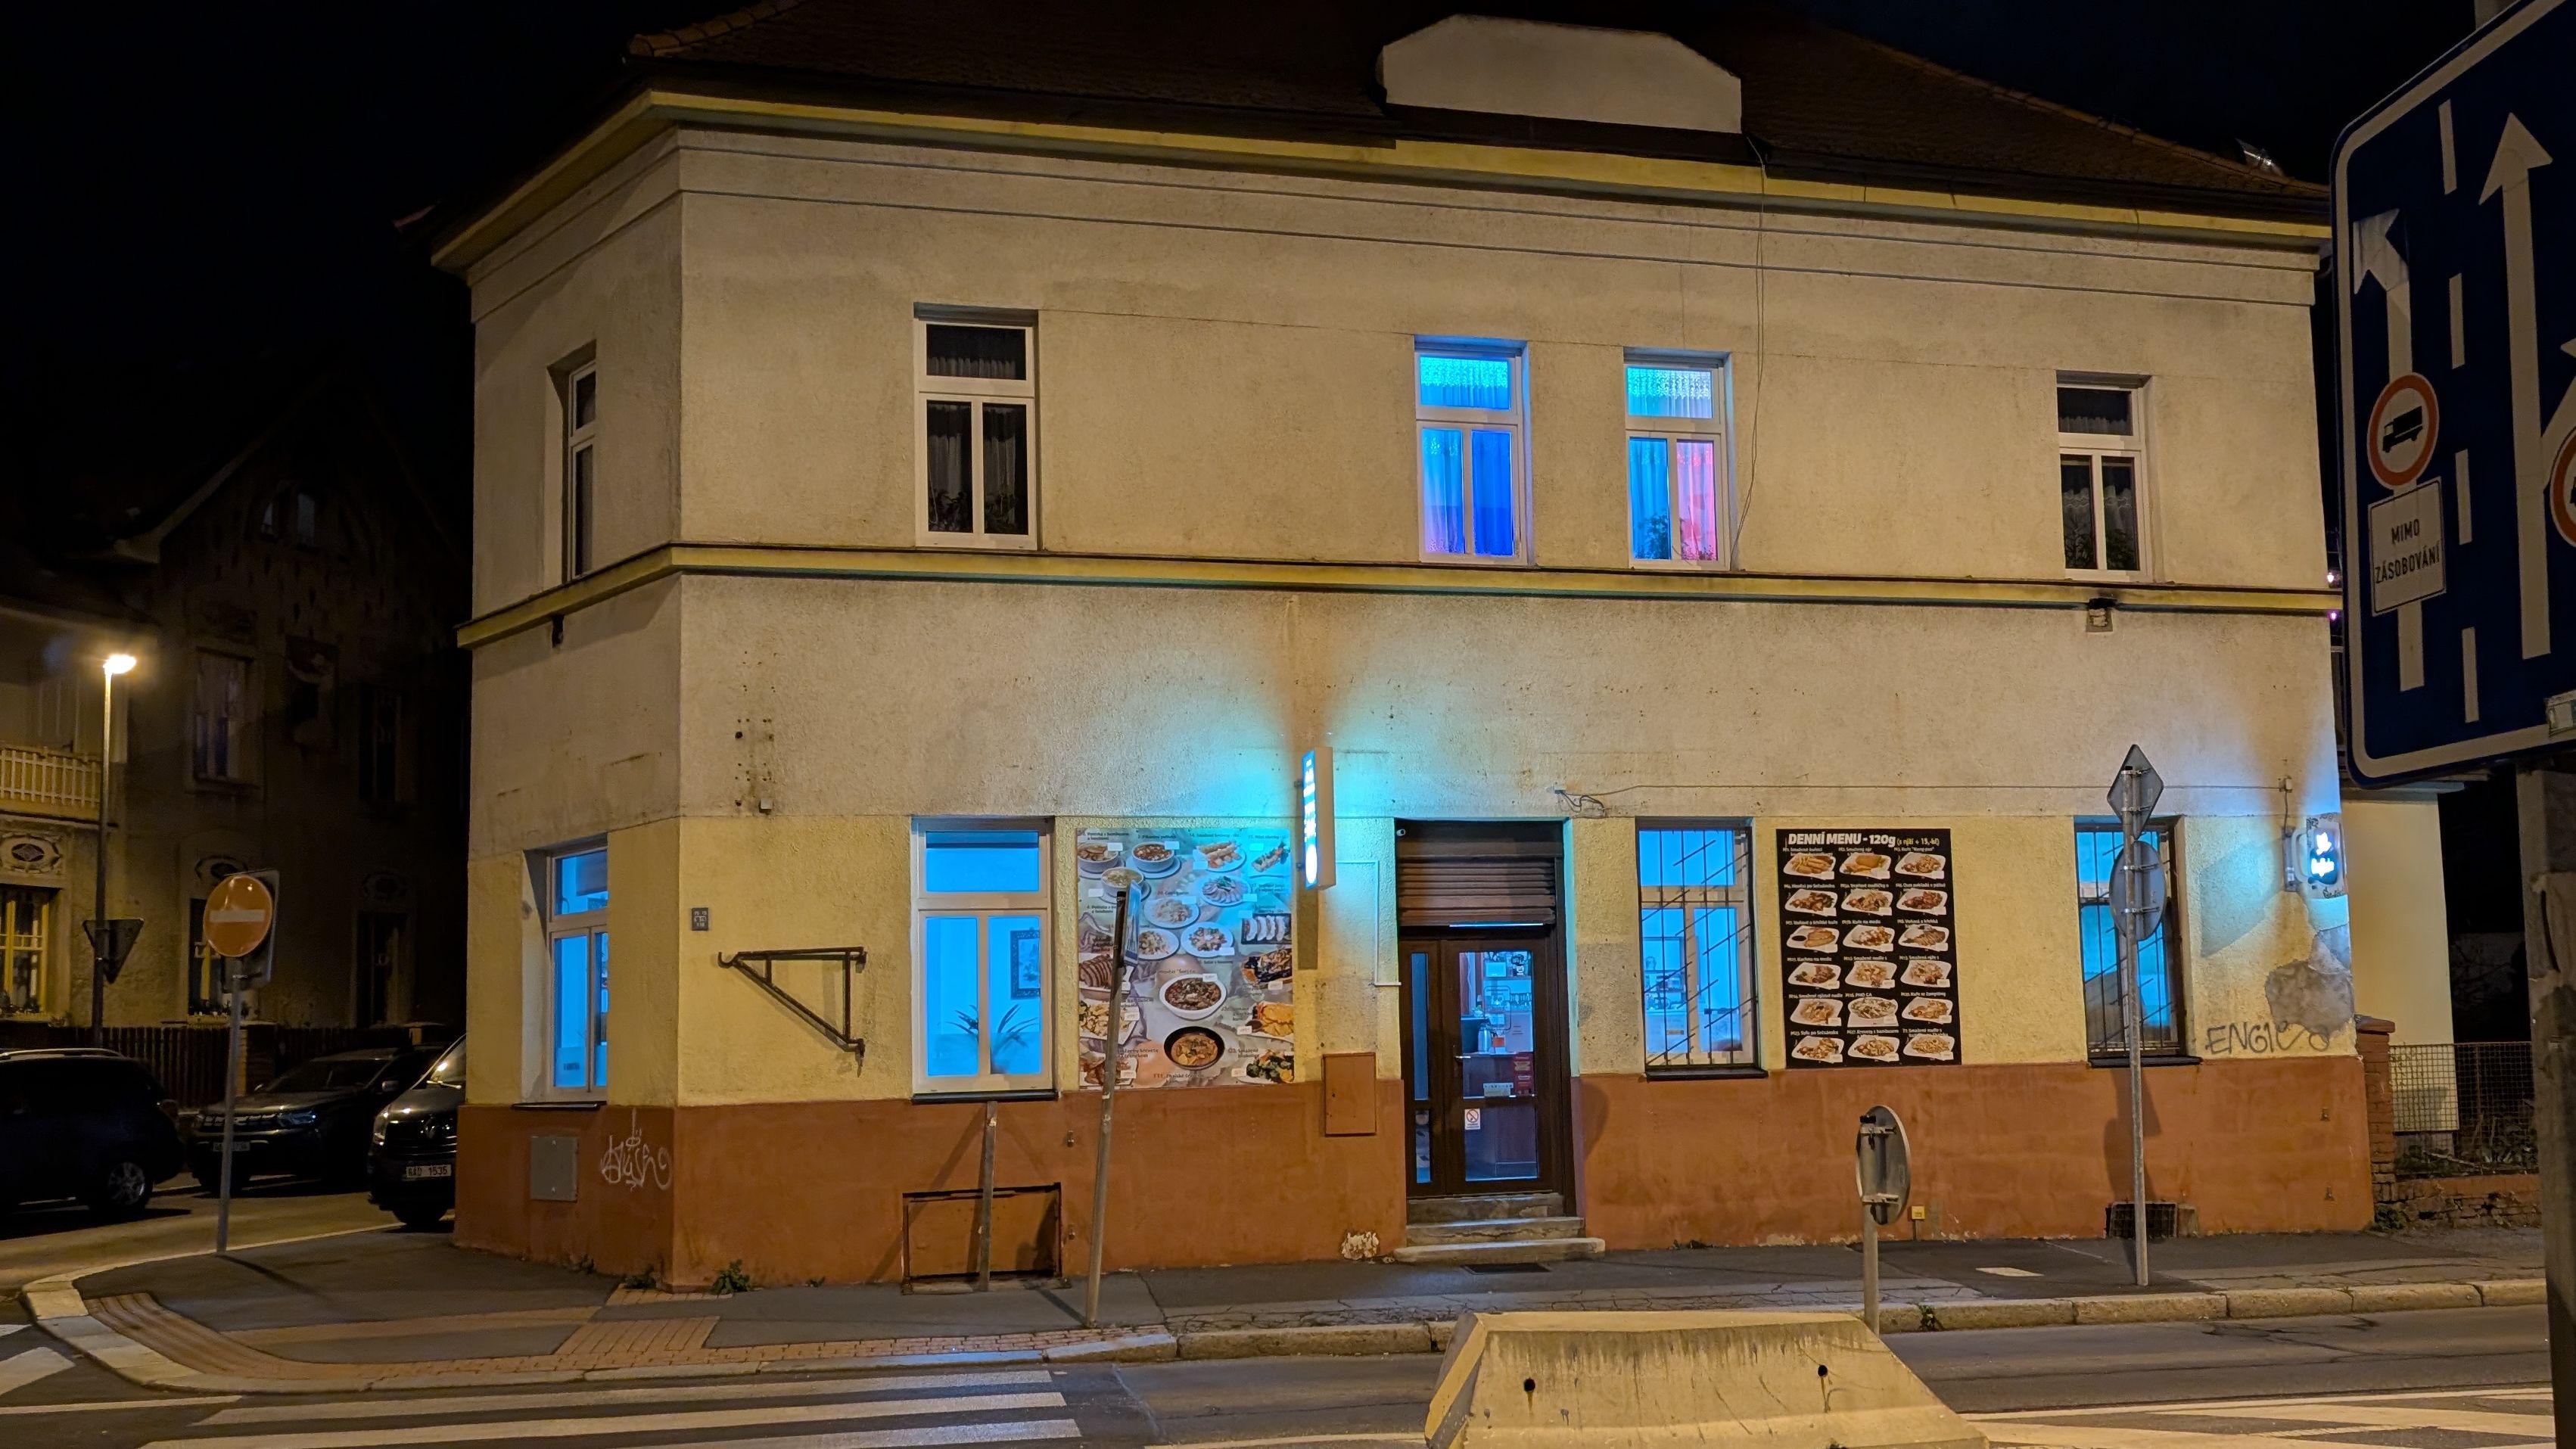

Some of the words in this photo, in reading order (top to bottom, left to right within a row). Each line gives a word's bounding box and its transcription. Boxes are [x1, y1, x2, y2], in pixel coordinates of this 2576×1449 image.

[2391, 518, 2420, 544] MIMO
[2375, 540, 2441, 583] ZÁSOBOVÁNÍ
[1787, 831, 1825, 845] DENNÍ
[1826, 833, 1862, 845] MENU
[1869, 834, 1896, 847] 120g
